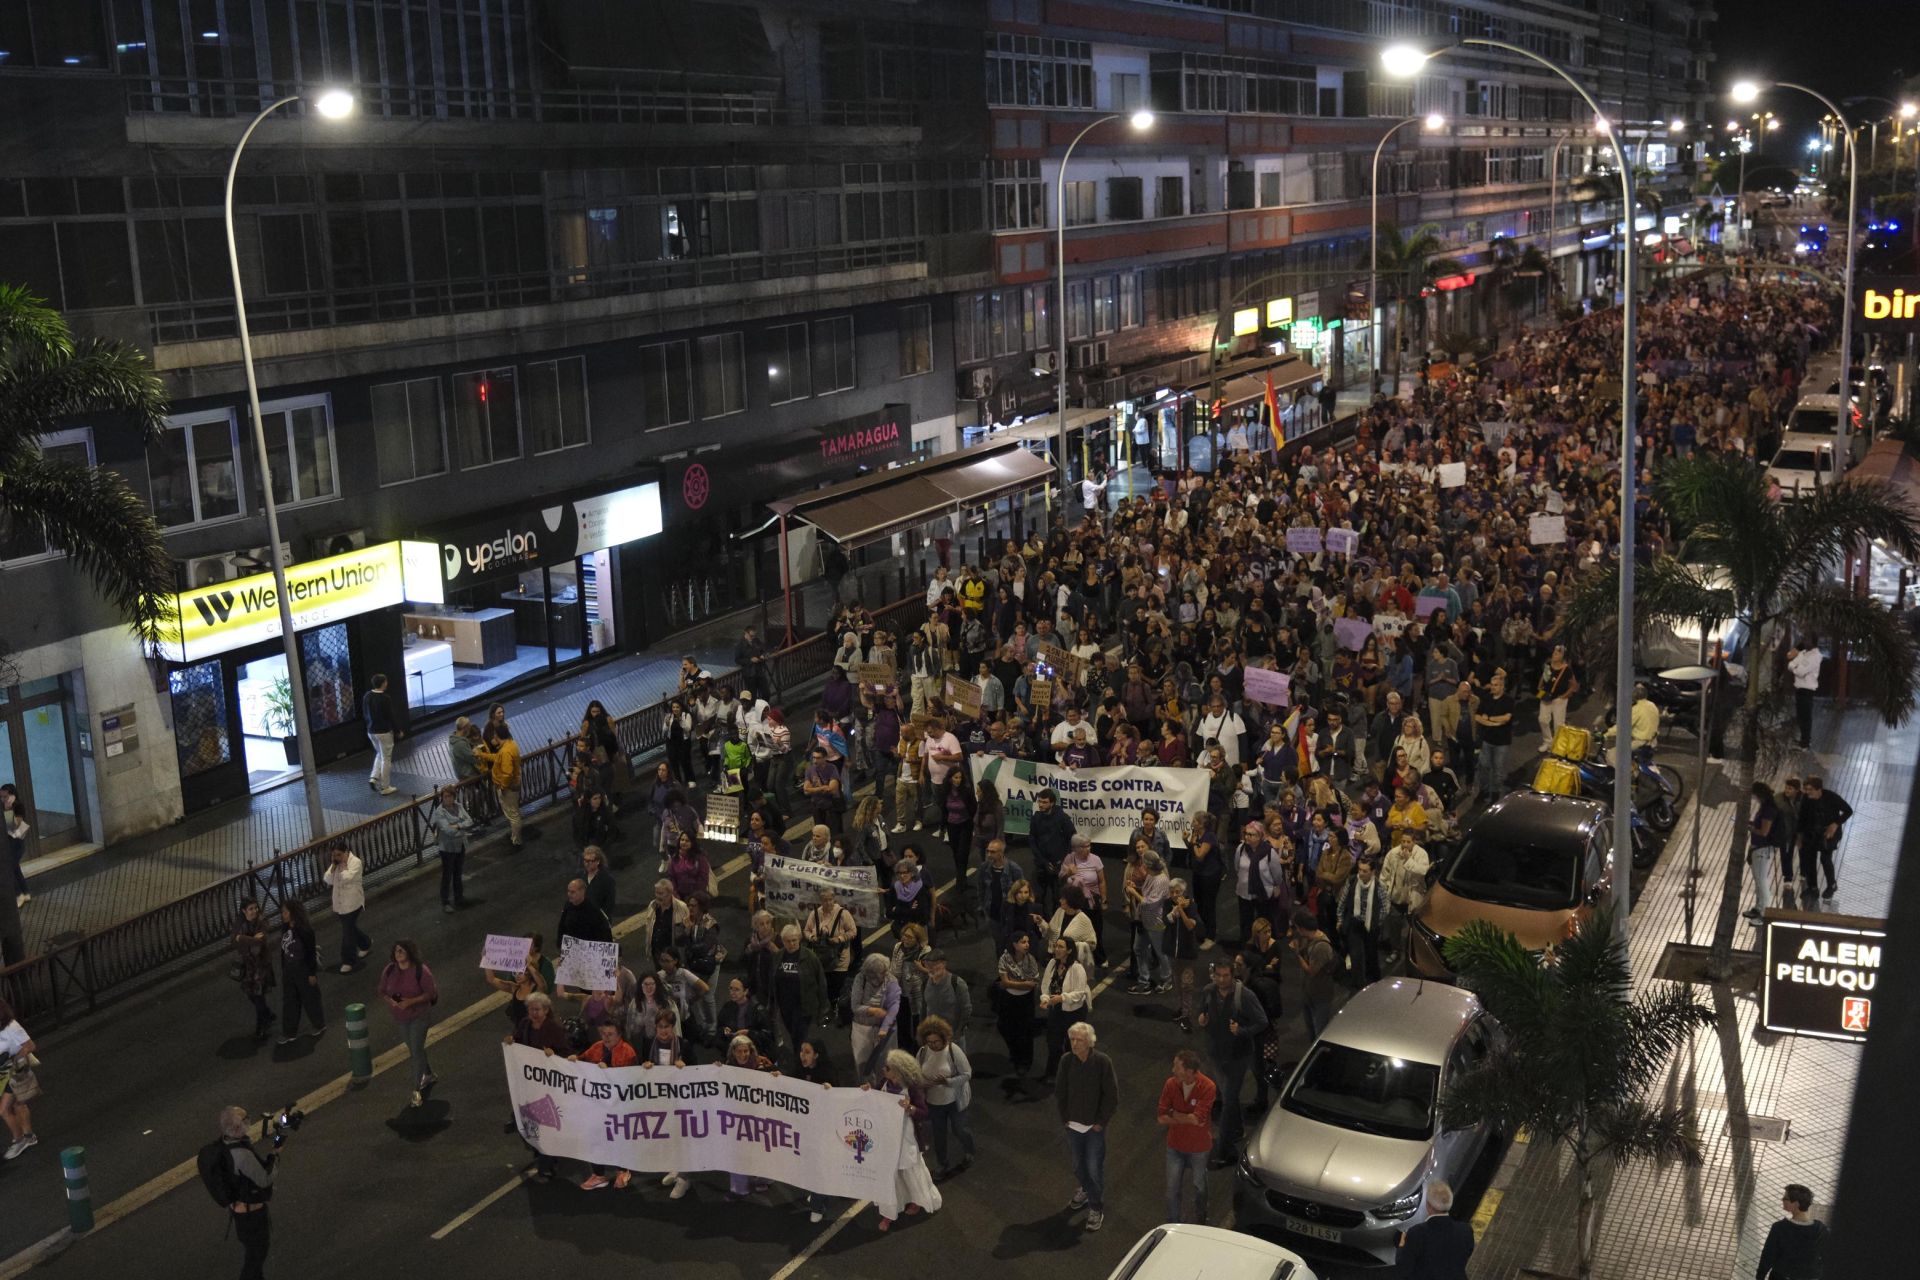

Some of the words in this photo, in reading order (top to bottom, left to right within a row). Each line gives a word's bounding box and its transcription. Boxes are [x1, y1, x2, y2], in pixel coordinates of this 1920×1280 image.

[820, 422, 899, 458] TAMARAGUA
[465, 528, 537, 573] ypsilon
[240, 576, 328, 613] Wetern
[331, 562, 387, 589] Union
[266, 608, 330, 633] CANGE
[1028, 774, 1097, 792] HOMBRES
[1101, 779, 1164, 793] CONTRA
[1007, 788, 1026, 801] LA
[1029, 790, 1106, 811] VENCIA
[1110, 797, 1185, 814] MACHISTA
[1108, 816, 1126, 828] nos
[1797, 938, 1881, 968] ALEM
[1776, 962, 1876, 991] PELUQU
[523, 1063, 577, 1095] CONTRA
[582, 1078, 612, 1100] LAS
[614, 1081, 720, 1103] VIOLENCIAS
[723, 1082, 810, 1115] MACHISTAS
[604, 1110, 670, 1142] ¡HAZ
[674, 1109, 709, 1139] TU
[716, 1109, 801, 1156] PARTE!
[844, 1116, 873, 1130] RED
